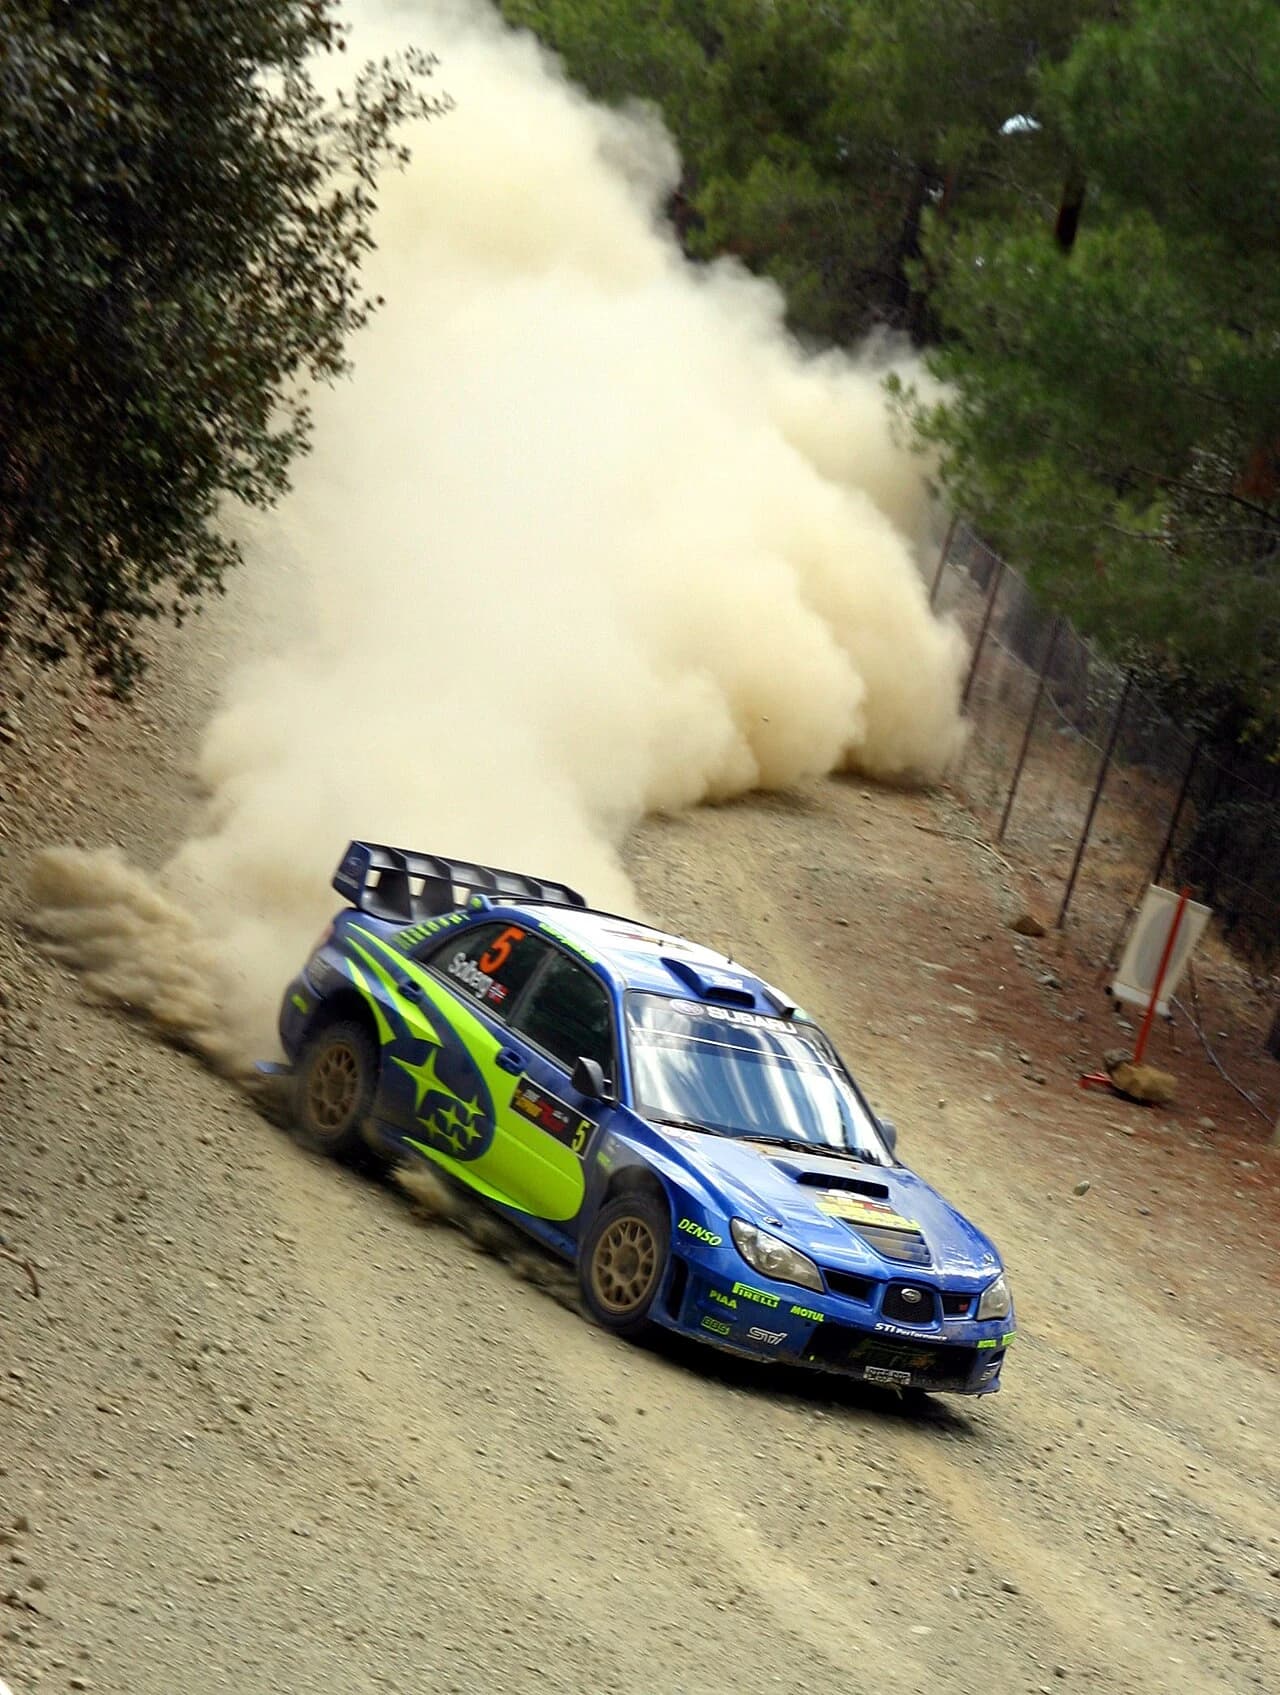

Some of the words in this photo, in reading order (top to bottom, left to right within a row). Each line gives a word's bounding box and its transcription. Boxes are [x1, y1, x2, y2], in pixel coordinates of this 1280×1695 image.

[480, 926, 526, 973] 5
[706, 1006, 797, 1033] SUBARU
[572, 1120, 590, 1152] 5
[678, 1219, 722, 1246] DENSO
[709, 1290, 737, 1309] PIAA
[732, 1282, 780, 1308] PIRELLI
[790, 1305, 824, 1322] MOTUL
